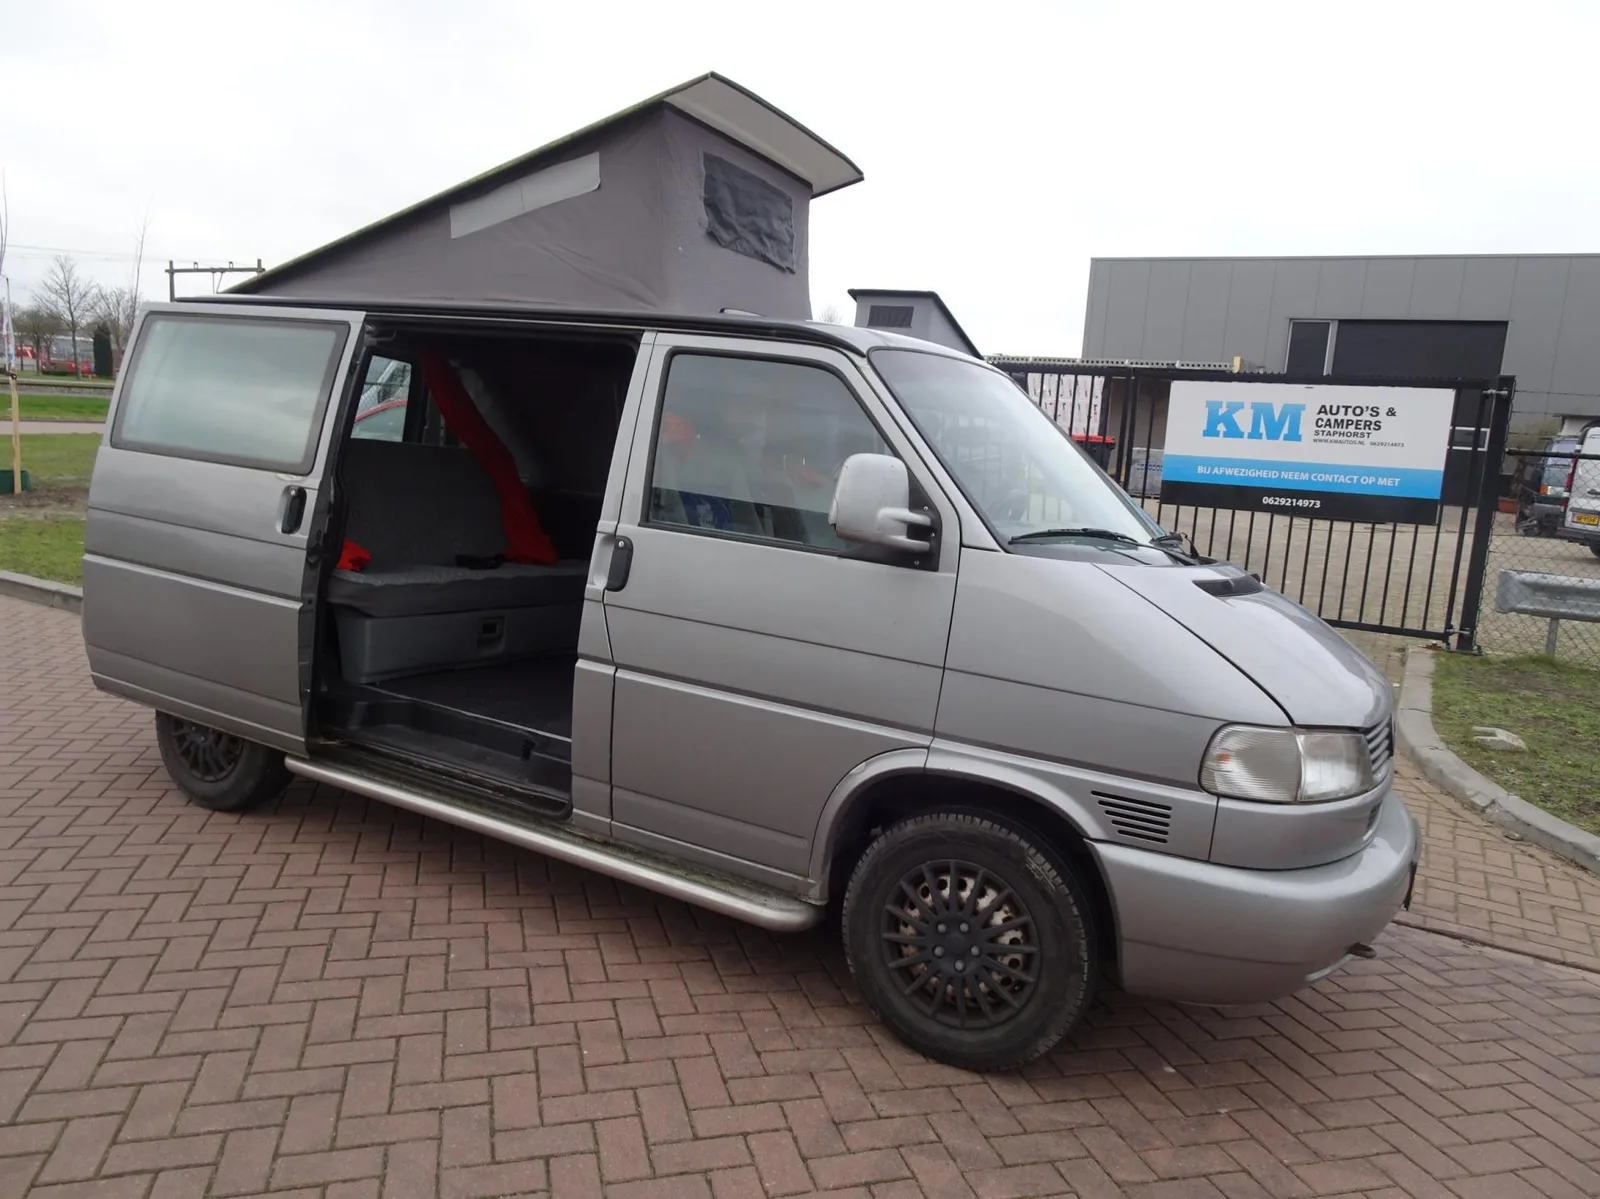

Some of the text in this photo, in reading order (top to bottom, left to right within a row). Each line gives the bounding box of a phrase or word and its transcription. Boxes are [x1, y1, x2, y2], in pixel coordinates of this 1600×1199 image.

[1317, 404, 1397, 418] AUTO'S &
[1202, 400, 1306, 442] KM
[1315, 417, 1382, 431] CAMPERS
[1314, 430, 1372, 439] STAPHORST
[1313, 438, 1365, 446] WWW.KMAUTOS.NL
[1197, 465, 1401, 488] BIJ AFWEZIGHEID NEEM CONTACT OP MET
[1262, 496, 1321, 509] 0629214973
